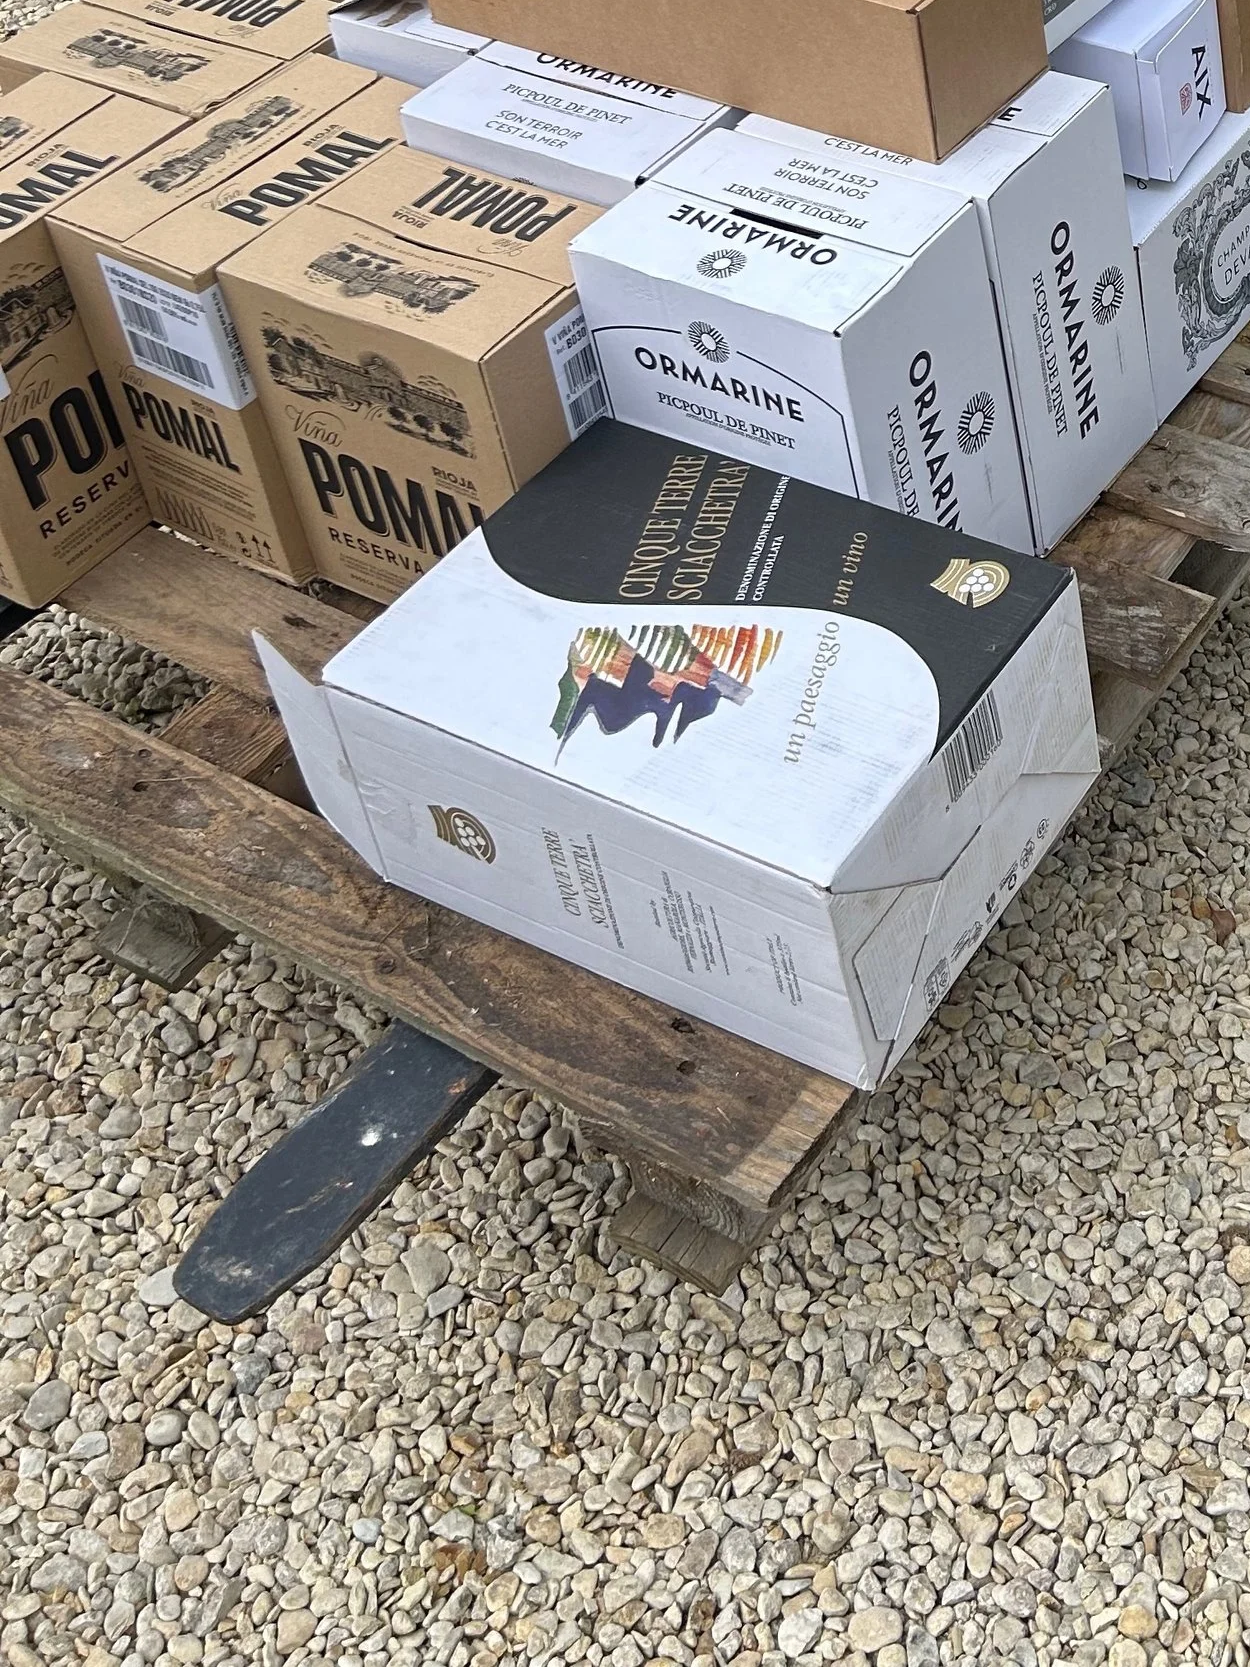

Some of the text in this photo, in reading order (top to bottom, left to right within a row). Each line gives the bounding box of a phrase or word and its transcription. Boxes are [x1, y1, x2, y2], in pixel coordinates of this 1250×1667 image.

[503, 83, 563, 108] PICPOUL
[564, 101, 585, 114] DE
[585, 108, 633, 126] PINET
[1191, 44, 1212, 121] AIX
[26, 142, 66, 167] RIOJA
[303, 123, 340, 147] RIOJA
[496, 109, 529, 124] SON
[529, 117, 584, 141] TERROIR
[519, 128, 537, 141] LA
[538, 135, 569, 150] MER
[824, 136, 914, 167] C'EST LA MER
[218, 130, 399, 227] POMAL
[773, 167, 871, 201] SON TERROIR
[788, 157, 821, 174] MER
[823, 165, 844, 178] LA
[391, 209, 429, 230] RIOJA
[412, 166, 578, 243] POMAL
[667, 203, 839, 266] ORMARINE
[722, 182, 871, 230] PICPOUL DE PINET
[1032, 269, 1069, 438] PICPOUL DE PINET
[1050, 220, 1100, 440] ORMARINE
[634, 346, 806, 423] ORMARINE
[121, 381, 243, 476] POMAL
[284, 403, 347, 448] Viña
[656, 390, 797, 451] PICPOUL DE PINET
[886, 403, 914, 493] PICPOUL
[431, 465, 479, 493] RIOJA
[327, 526, 425, 575] RESERVA
[618, 453, 709, 599] CINQUE TERRE
[734, 475, 791, 603] DENOMINAZIONE DI ORIGINE
[752, 534, 786, 603] CONTROLLATA
[832, 531, 869, 607] un vino
[783, 620, 841, 765] un paesaggio
[541, 827, 582, 917] CINQUE TERRE
